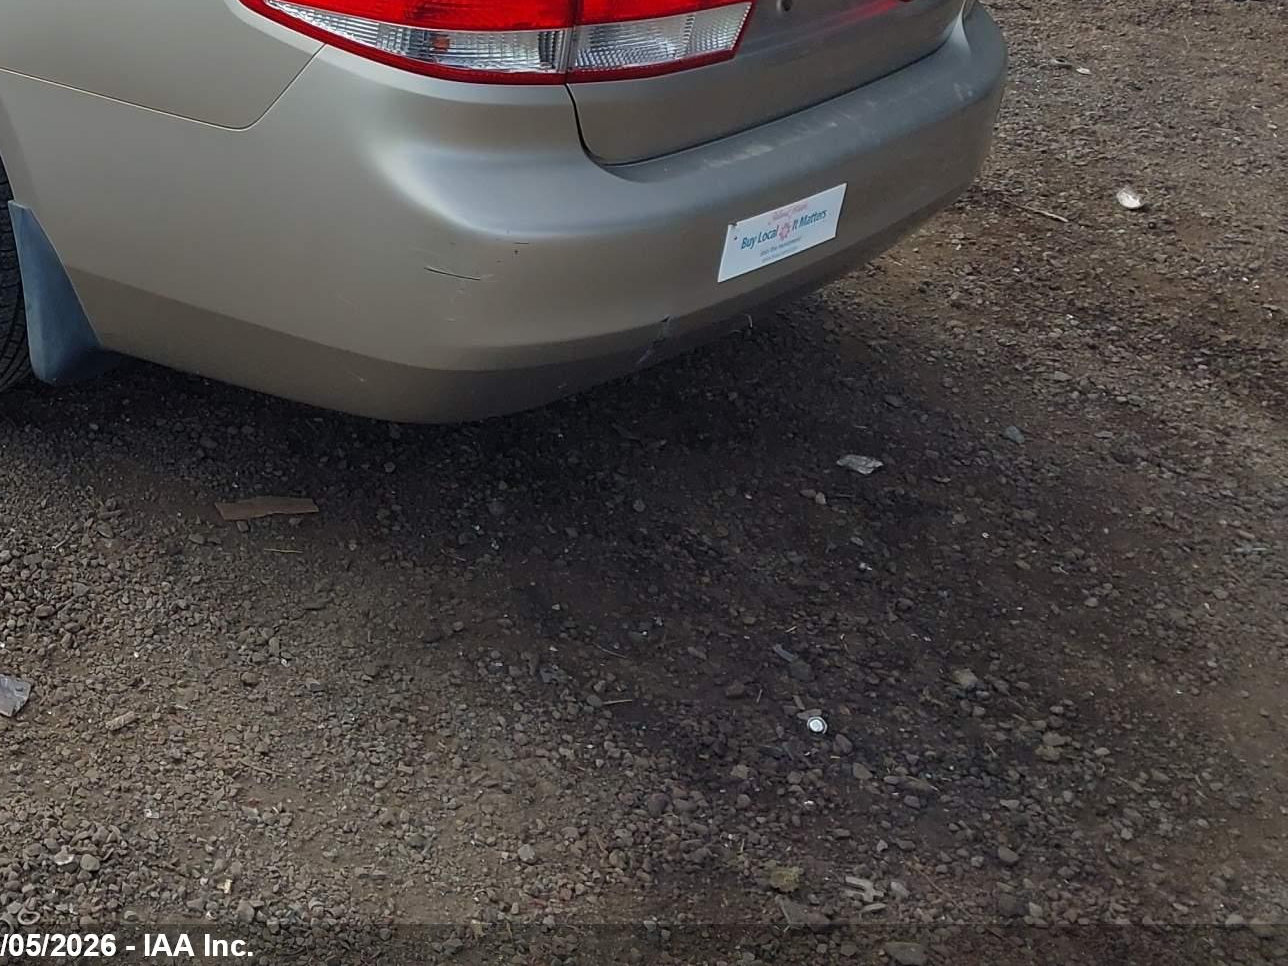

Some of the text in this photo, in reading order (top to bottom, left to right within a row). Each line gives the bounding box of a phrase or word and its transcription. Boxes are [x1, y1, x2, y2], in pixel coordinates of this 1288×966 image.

[740, 235, 758, 250] Buy
[757, 225, 779, 244] Local
[799, 209, 827, 227] Matters
